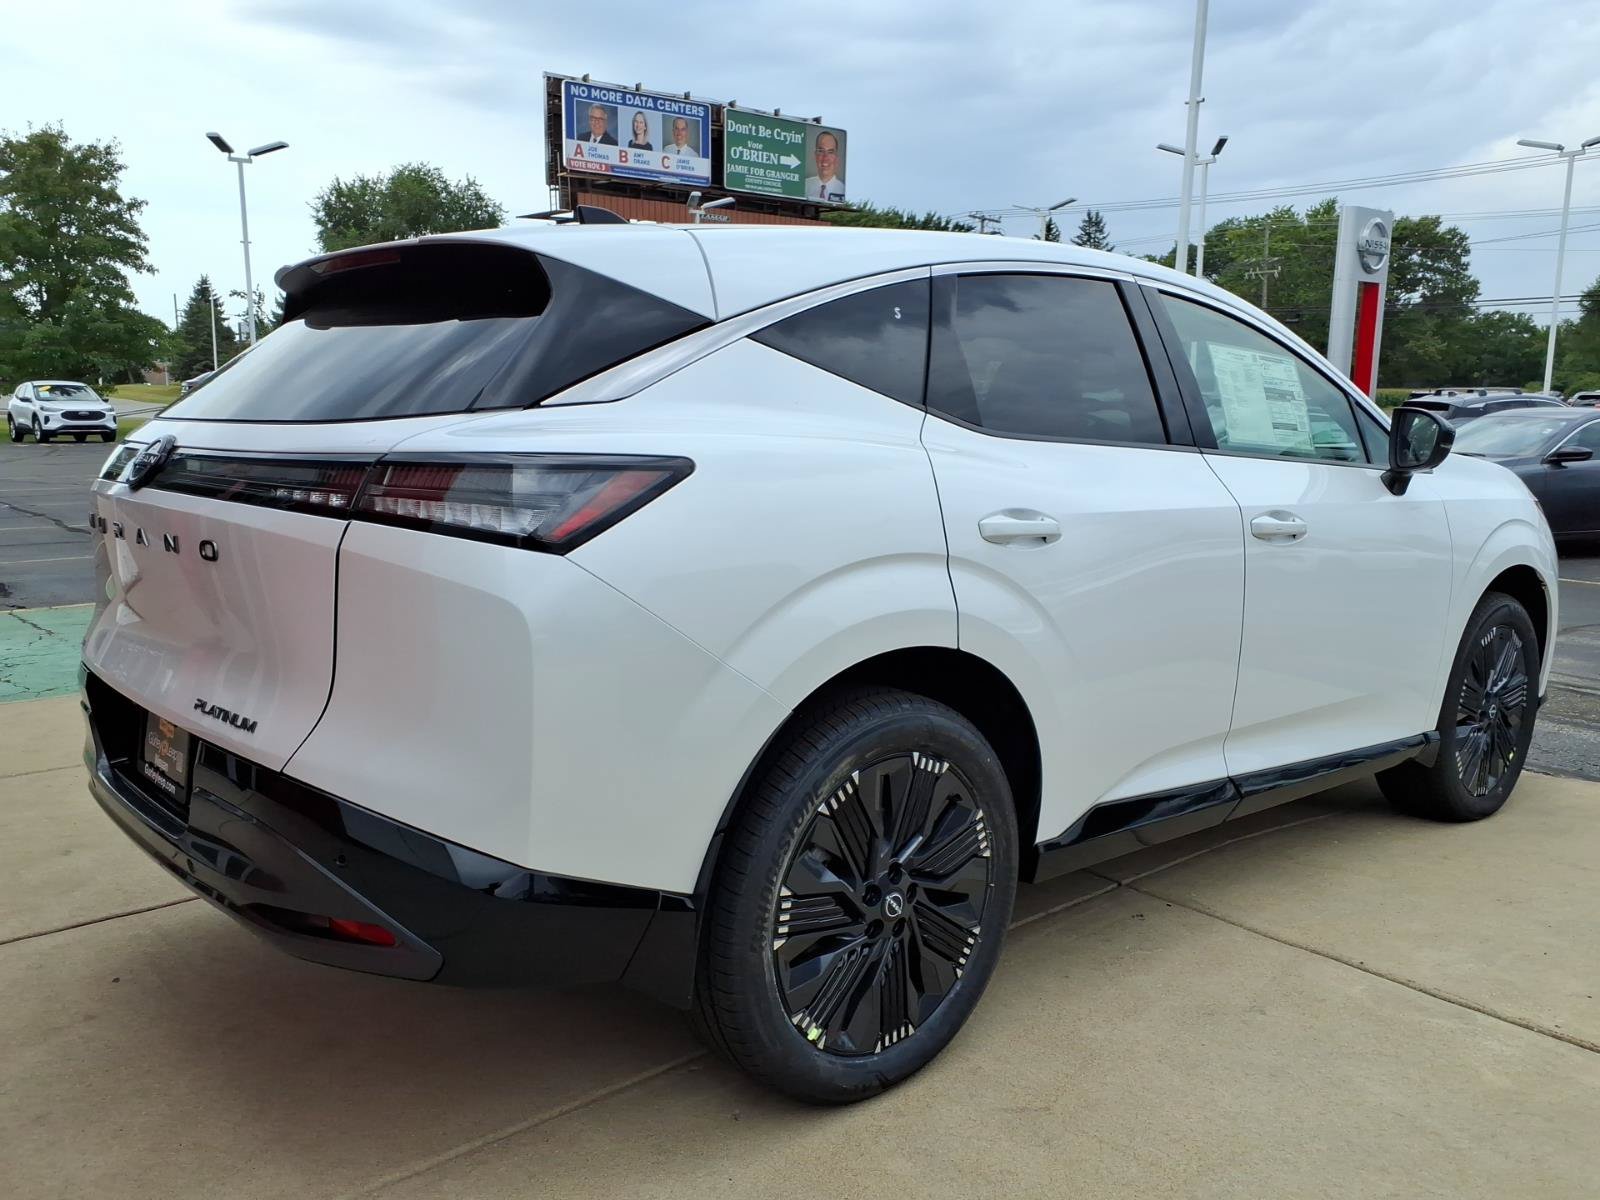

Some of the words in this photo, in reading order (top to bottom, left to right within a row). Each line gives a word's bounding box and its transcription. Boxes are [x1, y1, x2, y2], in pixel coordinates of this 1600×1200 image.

[571, 85, 588, 96] NO
[591, 88, 623, 103] MORE
[626, 95, 655, 109] DATA
[657, 101, 705, 117] CENTERS
[727, 120, 756, 136] Don't
[758, 126, 772, 138] Be
[774, 128, 805, 145] Cryin'
[573, 144, 584, 158] A
[747, 140, 763, 150] Vote
[570, 159, 588, 169] VOTE
[619, 150, 629, 164] B
[661, 155, 671, 170] C
[730, 146, 780, 166] O'BRIEN
[727, 163, 750, 175] JAMIE
[750, 167, 765, 177] FOR
[766, 169, 801, 182] GRANGER
[193, 698, 259, 734] PLATINUM
